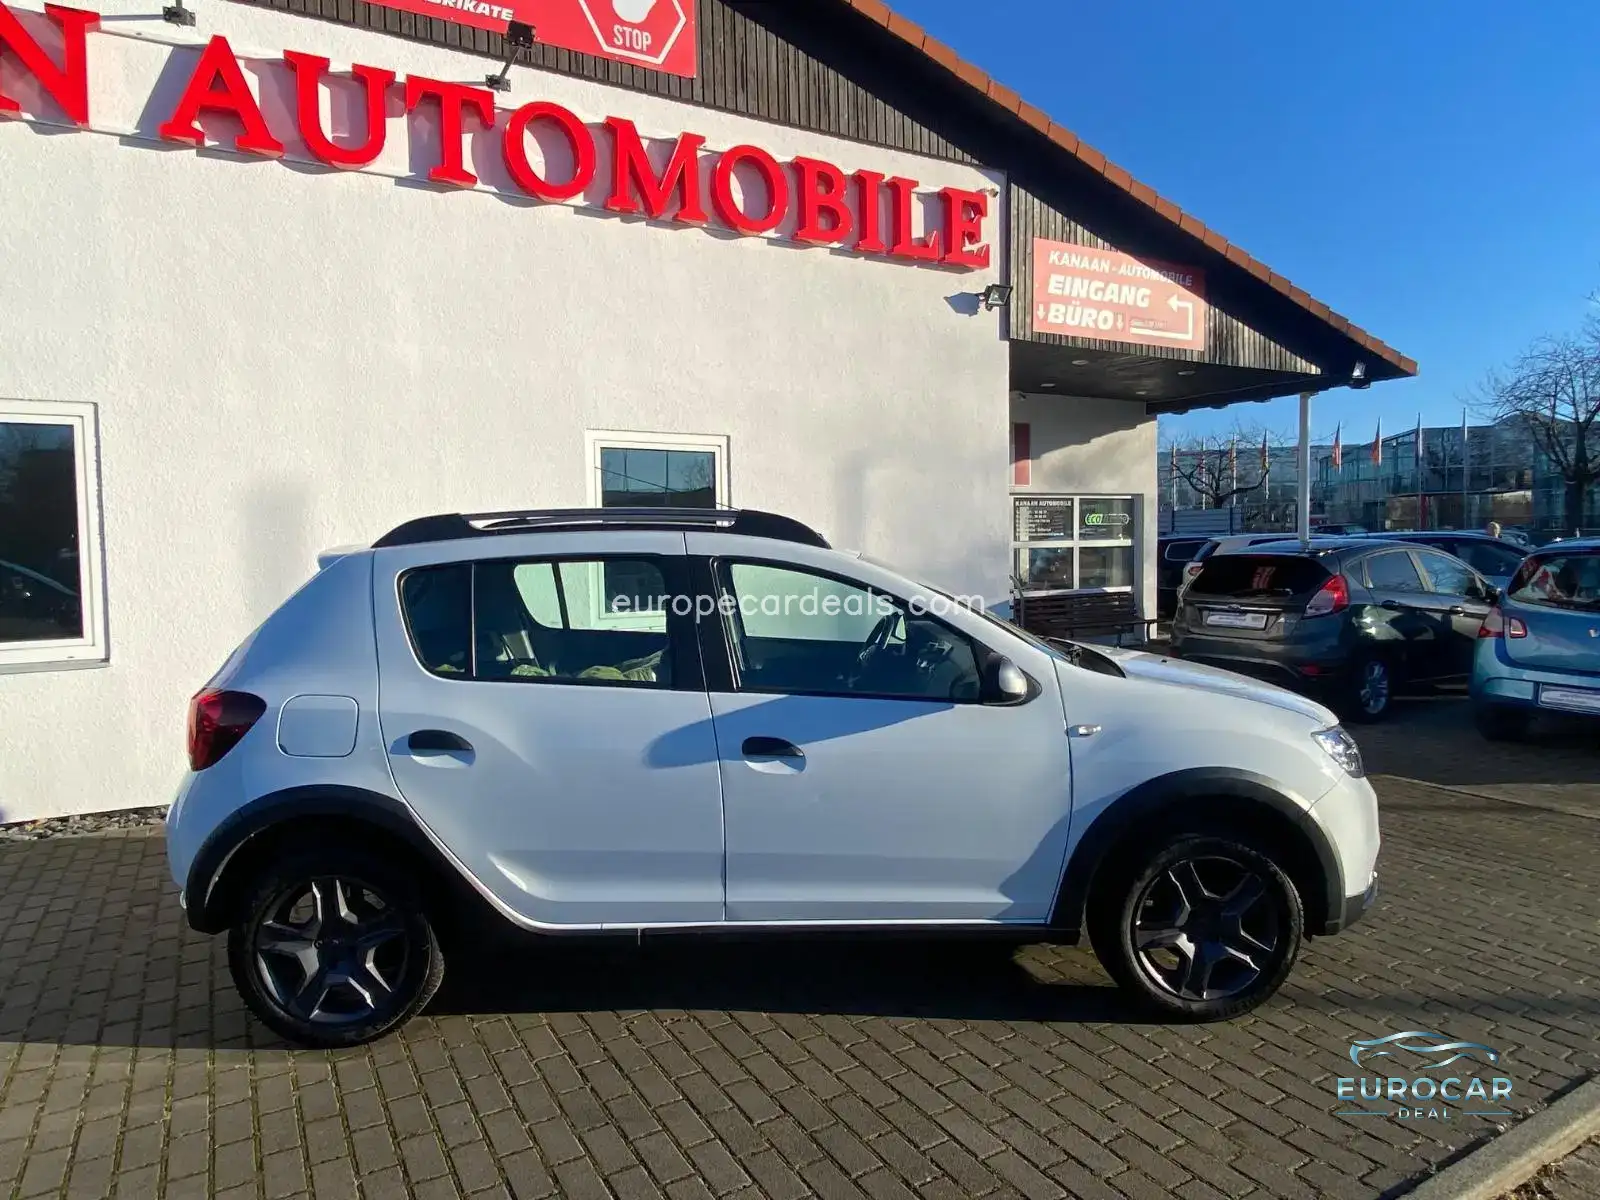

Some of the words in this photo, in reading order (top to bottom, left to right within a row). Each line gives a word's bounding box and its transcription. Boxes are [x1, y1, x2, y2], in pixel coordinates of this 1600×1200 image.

[613, 24, 652, 51] STOP
[160, 35, 991, 270] AUTOMOBILE
[1049, 250, 1111, 273] KANAAN
[1118, 263, 1192, 287] AUTOMOBILE
[1048, 273, 1152, 308] EINGANG
[1047, 301, 1115, 330] BÜRO
